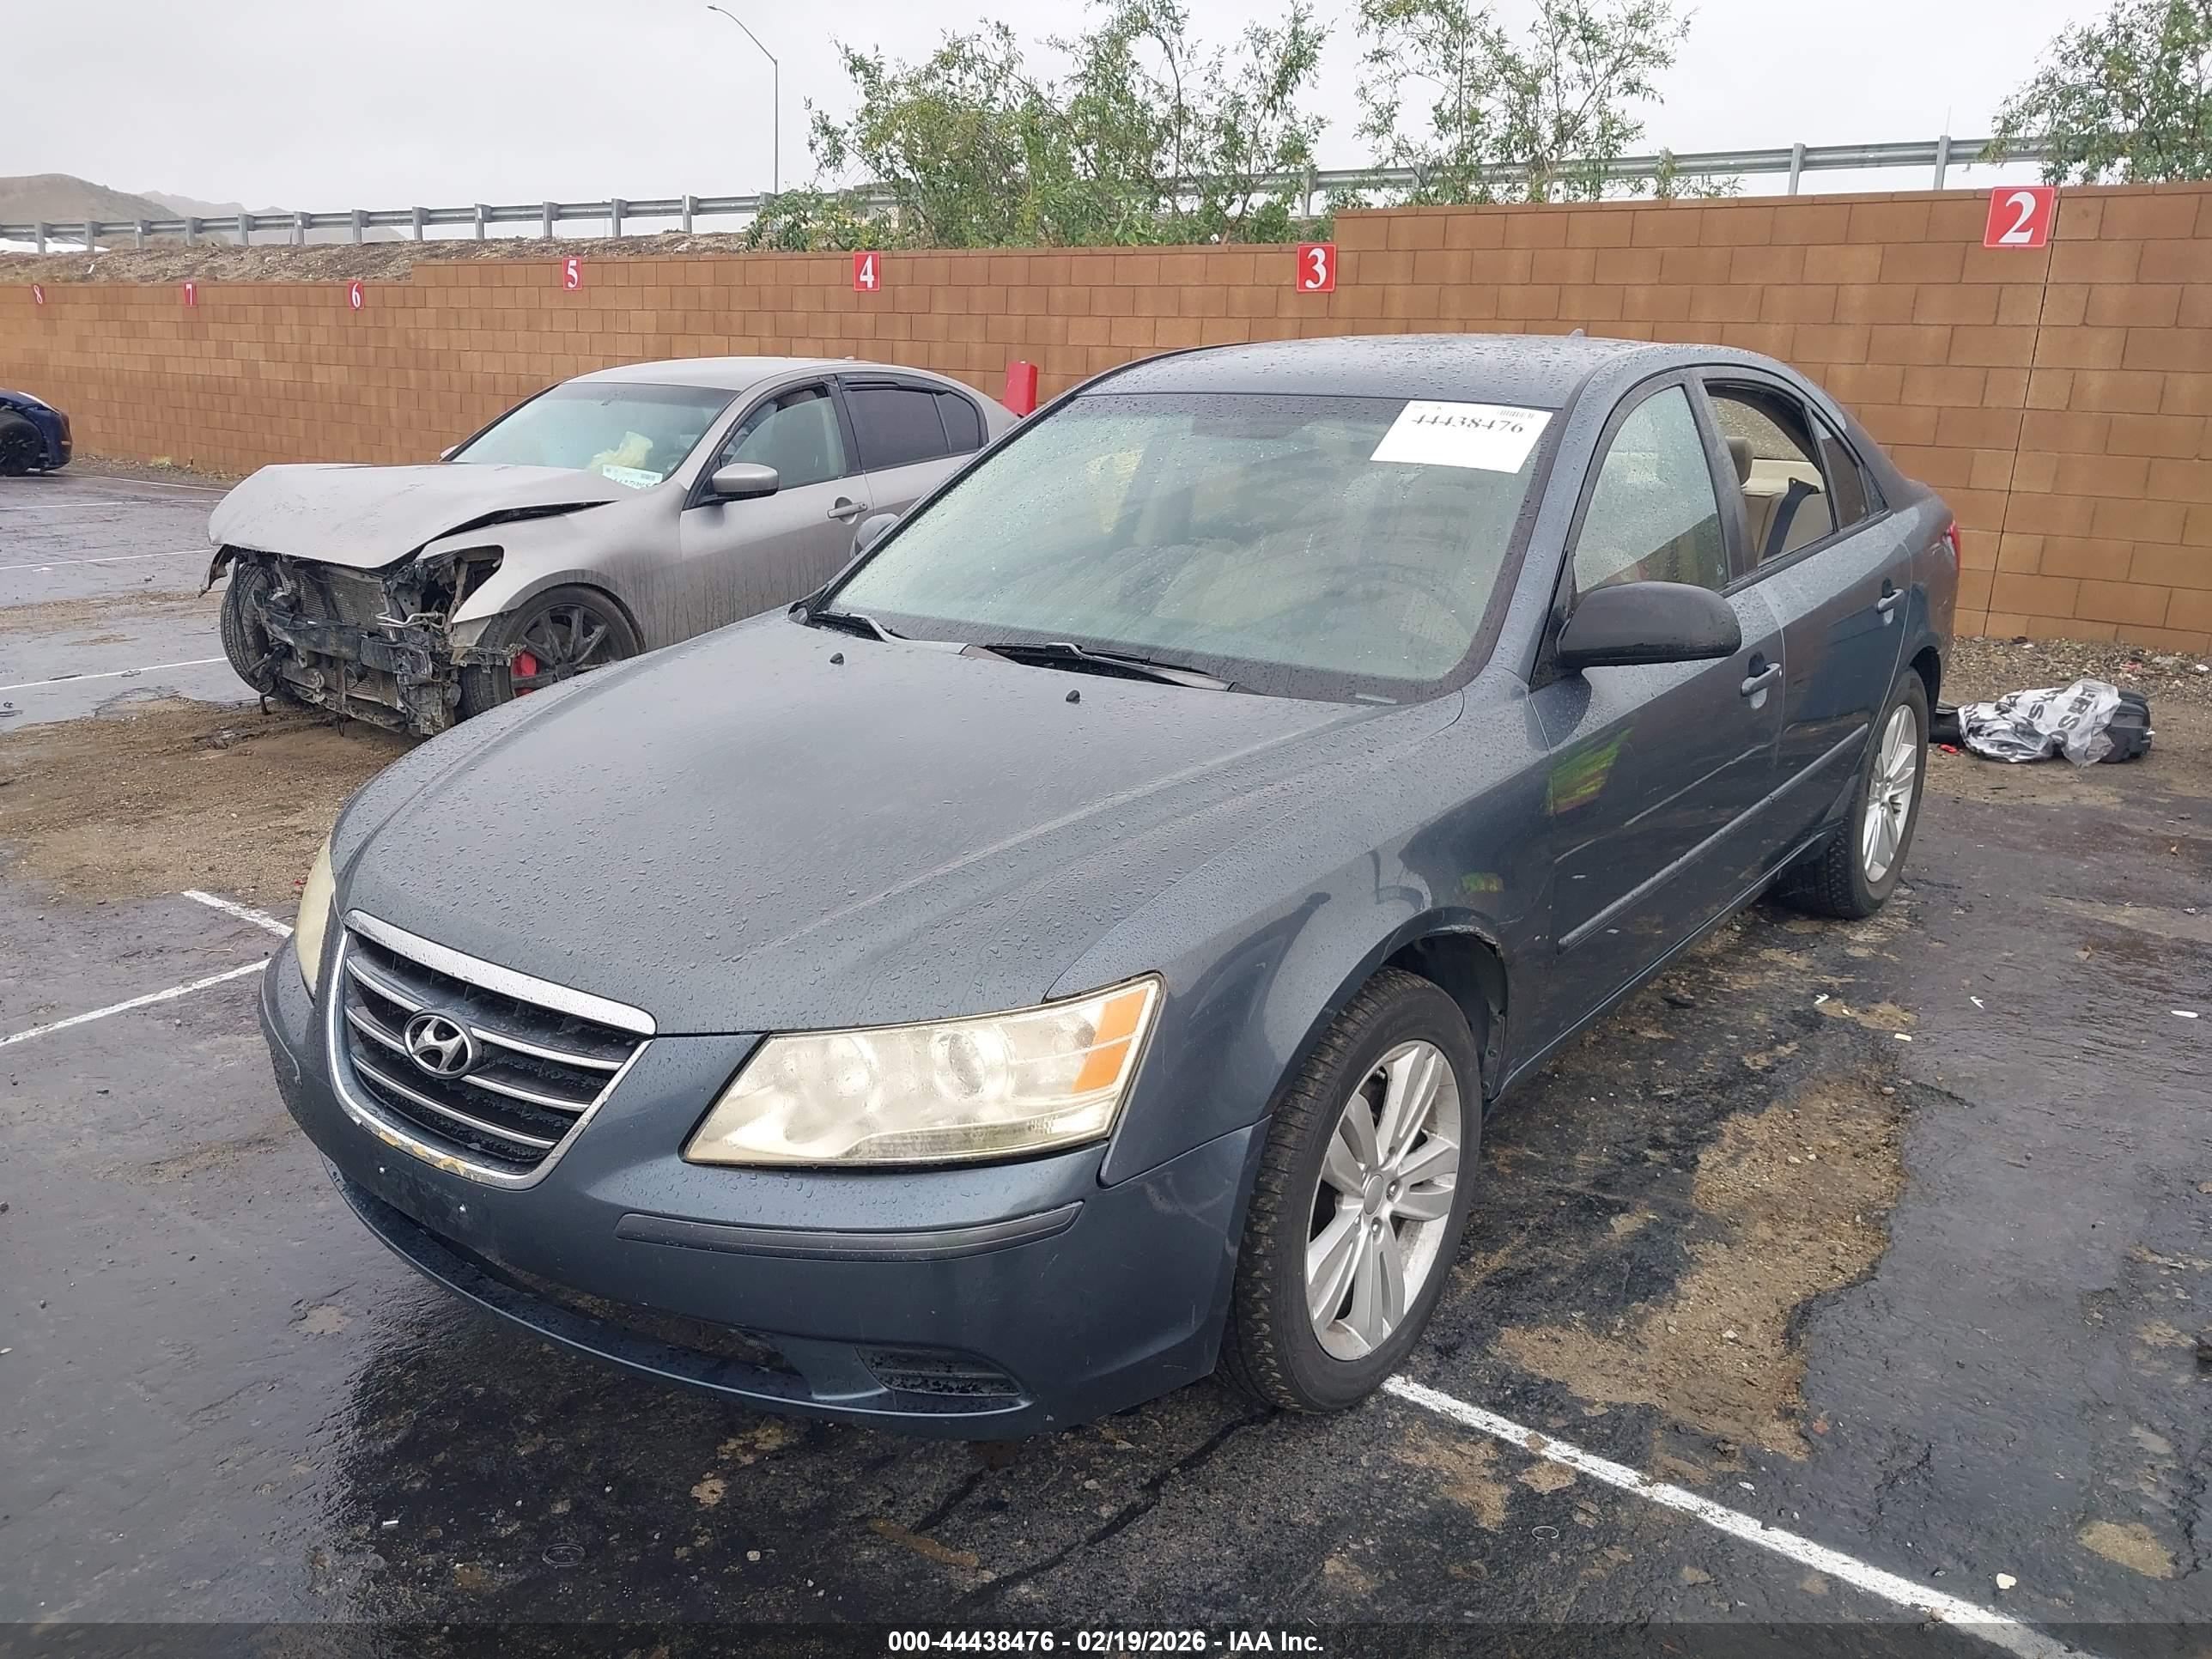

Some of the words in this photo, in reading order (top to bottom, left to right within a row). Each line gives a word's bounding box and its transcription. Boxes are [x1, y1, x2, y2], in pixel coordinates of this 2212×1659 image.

[1998, 191, 2037, 244] 2
[567, 259, 578, 289] 5
[859, 254, 875, 289] 4
[1305, 247, 1327, 289] 3
[33, 284, 43, 304] 8
[185, 283, 192, 307] 7
[352, 283, 361, 308] 6
[1411, 414, 1524, 434] 44438476
